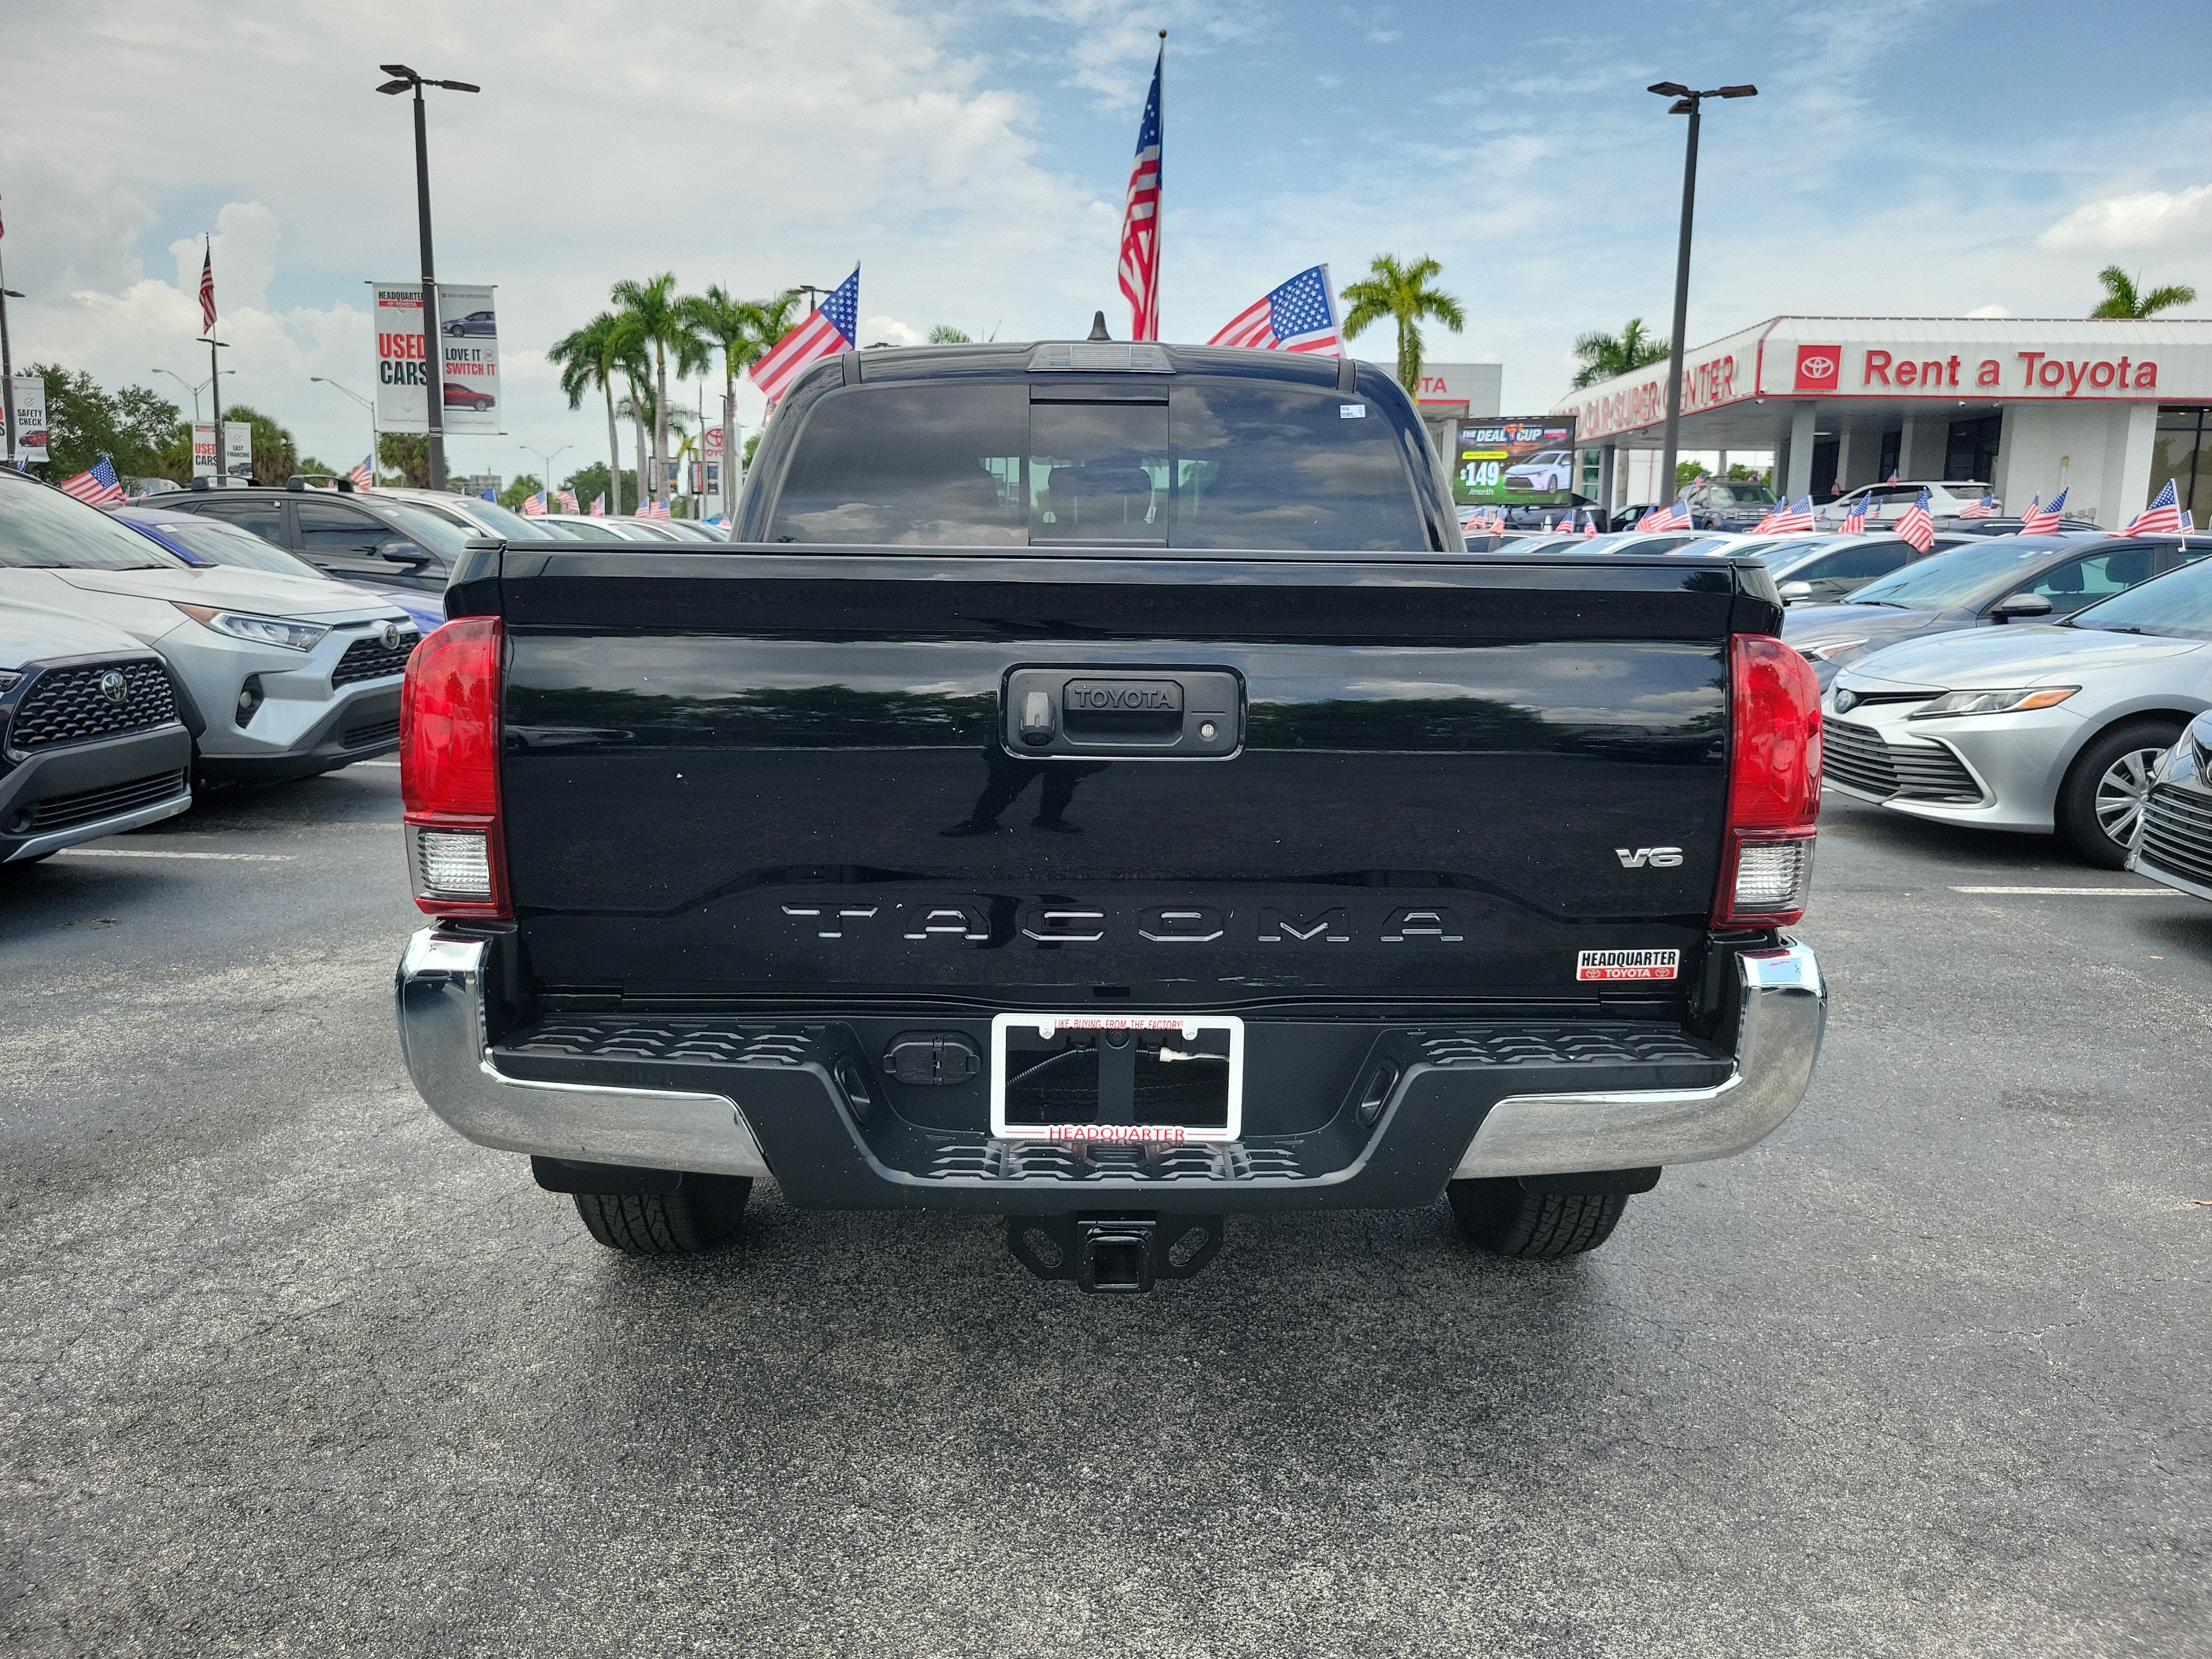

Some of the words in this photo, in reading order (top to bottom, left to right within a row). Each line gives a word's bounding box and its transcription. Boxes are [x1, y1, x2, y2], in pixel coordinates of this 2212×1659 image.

[445, 348, 470, 361] LOVE
[472, 349, 481, 362] IT
[446, 363, 484, 376] SWITCH
[487, 364, 496, 376] IT
[1864, 349, 1961, 387] Rent
[1976, 359, 2001, 387] a
[2018, 351, 2159, 397] Toyota
[17, 408, 43, 418] SAFETY
[19, 417, 43, 426] CHECK
[1462, 430, 1477, 438] THE
[1476, 428, 1508, 443] DEAL
[1516, 428, 1543, 442] CUP
[1459, 461, 1500, 487] $149
[1075, 689, 1174, 709] TOYOTA
[1615, 847, 1684, 868] V6
[780, 904, 1465, 942] TACOMA
[1581, 951, 1676, 967] HEADQUARTER
[1604, 968, 1651, 978] TOYOTA
[1054, 1019, 1070, 1029] LIKE
[1074, 1019, 1101, 1029] BUYING
[1105, 1019, 1126, 1030] FROM
[1131, 1020, 1145, 1030] THE
[1148, 1020, 1184, 1030] FACTORY!
[1049, 1127, 1184, 1141] HEADQUARTER
